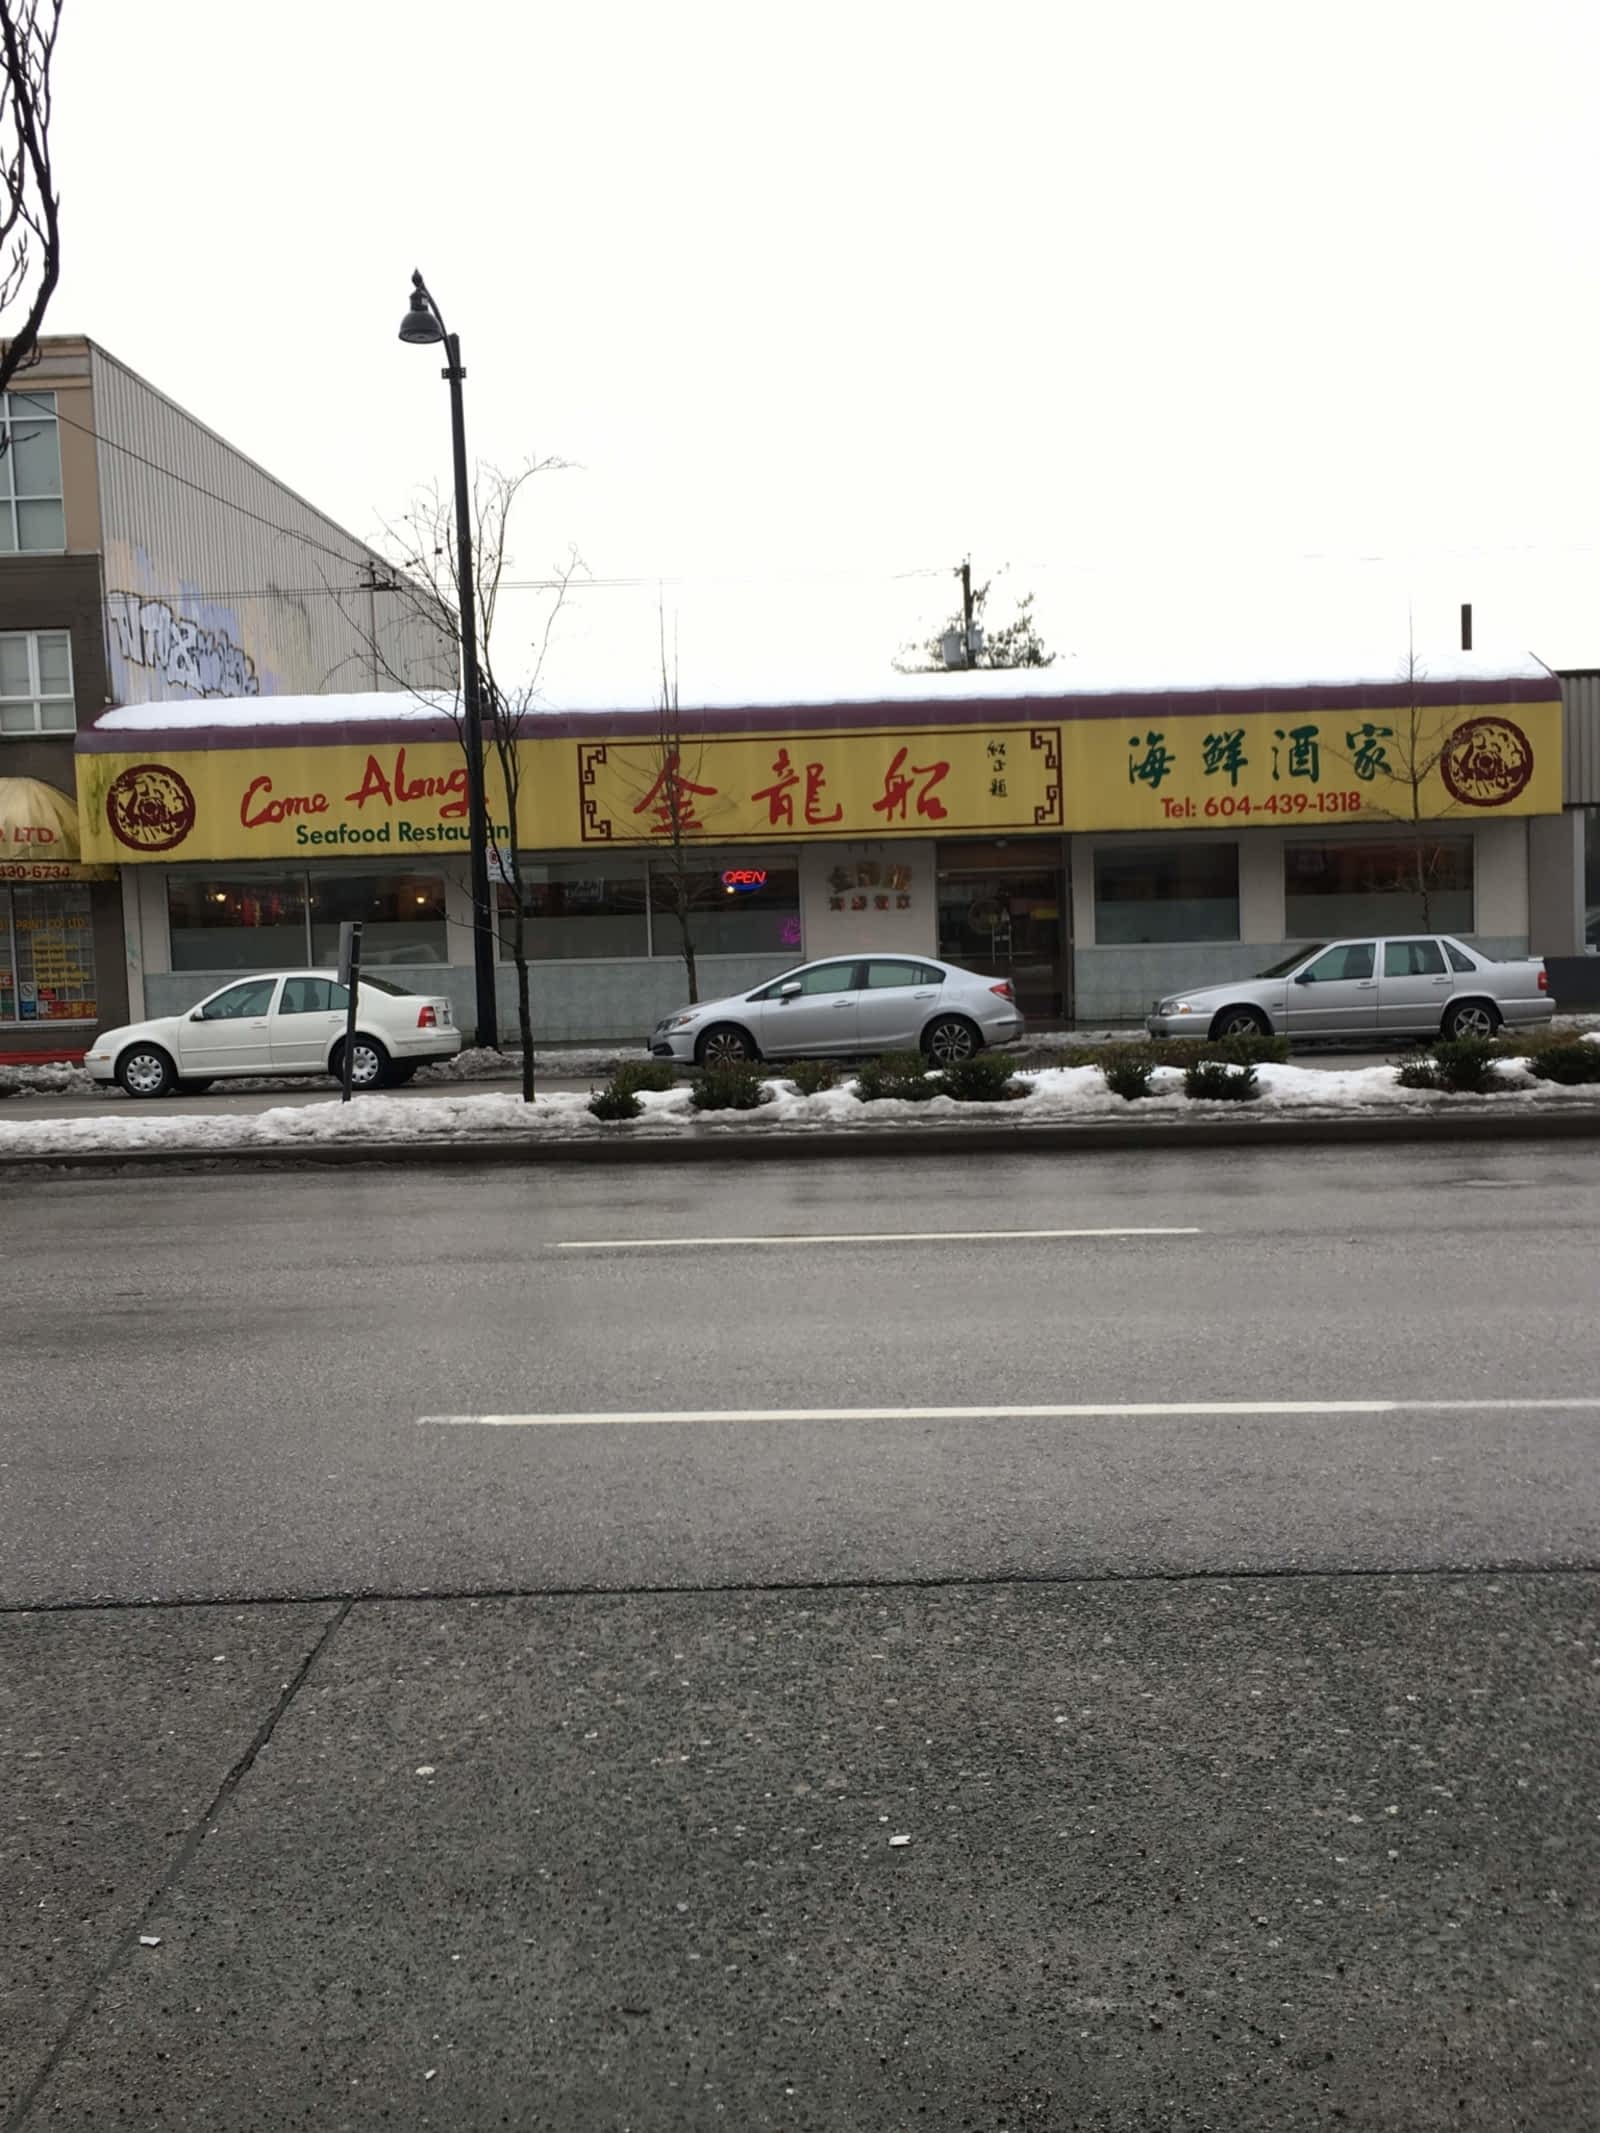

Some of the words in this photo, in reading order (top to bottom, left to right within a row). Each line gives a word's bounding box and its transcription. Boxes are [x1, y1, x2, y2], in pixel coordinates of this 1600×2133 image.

[1129, 723, 1394, 789] 海鮮酒家
[240, 775, 330, 829] Come
[345, 747, 489, 819] Along
[633, 748, 950, 833] 金龍船
[1161, 797, 1197, 819] Tel:
[1203, 791, 1362, 817] 604-439-1318
[13, 825, 58, 843] LTD.
[296, 822, 390, 845] Seafood
[398, 820, 513, 842] Restauan
[722, 870, 767, 884] OPEN
